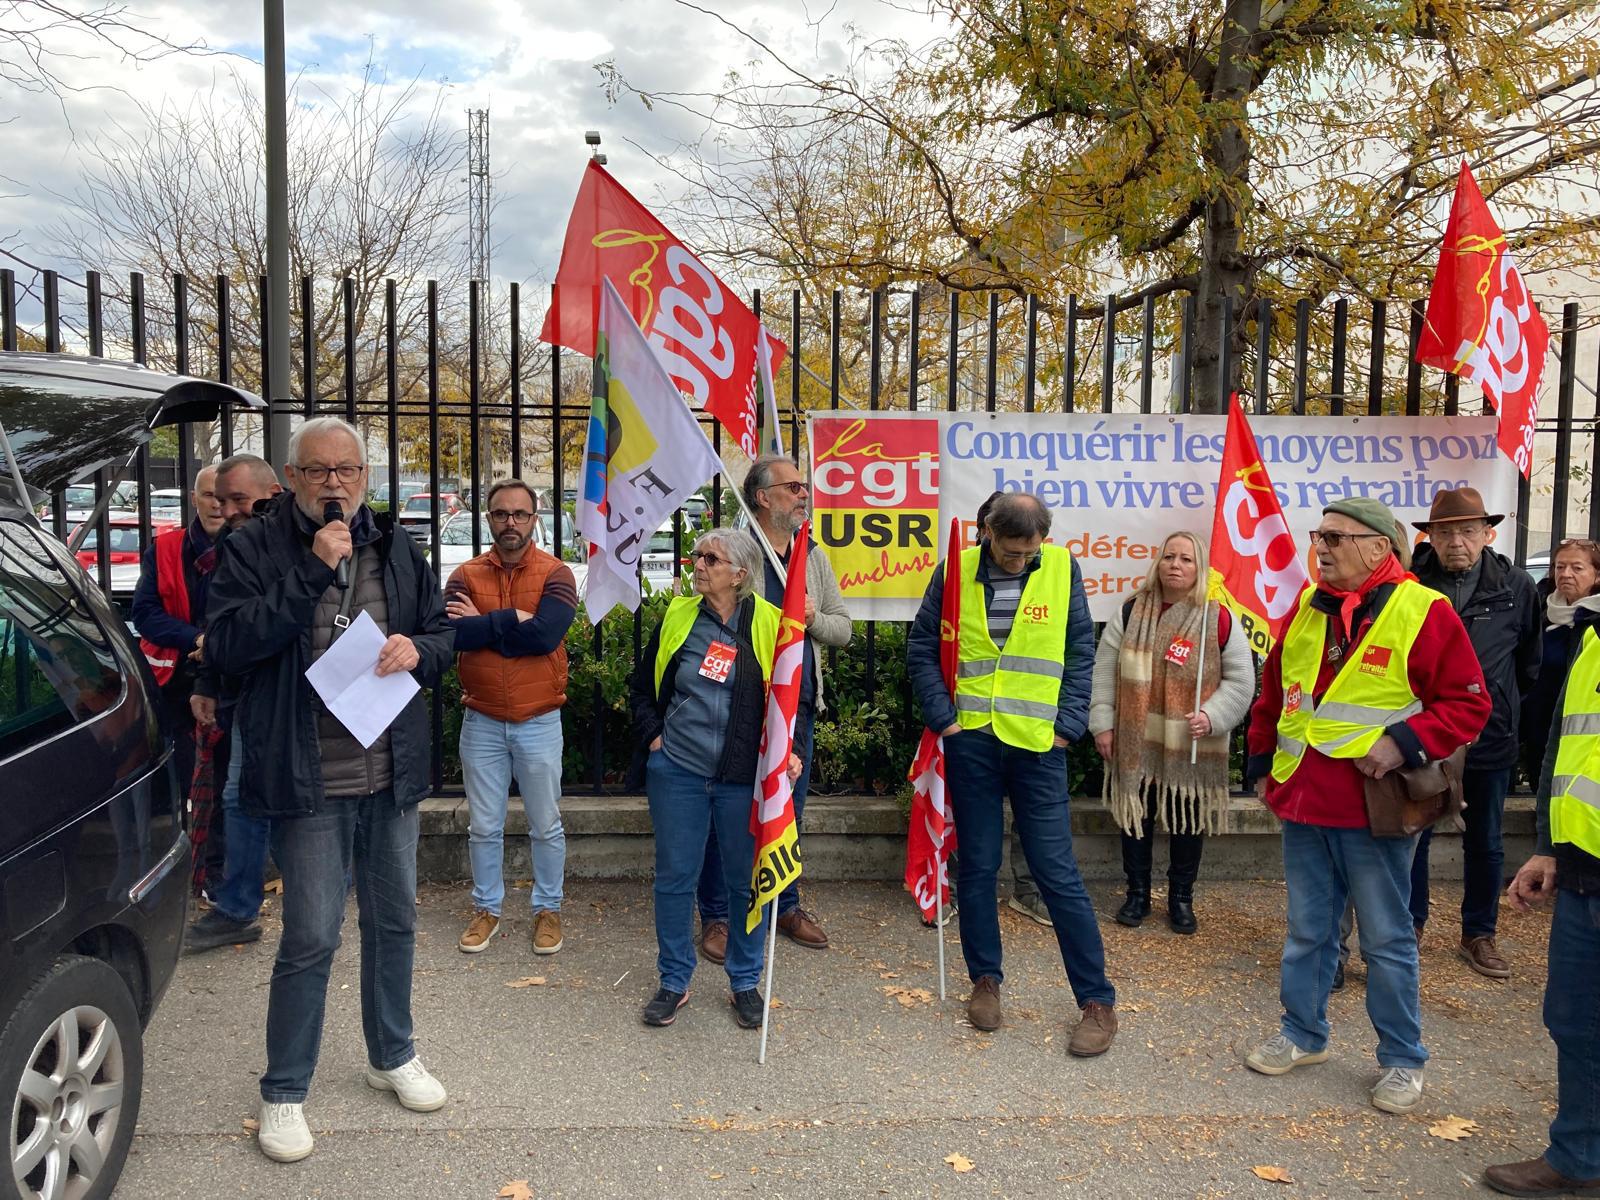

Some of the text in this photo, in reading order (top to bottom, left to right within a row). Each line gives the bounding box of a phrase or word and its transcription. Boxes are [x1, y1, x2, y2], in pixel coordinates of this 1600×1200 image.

[816, 418, 940, 462] la
[946, 420, 1167, 472] Conquérir
[1172, 422, 1226, 463] les
[1253, 434, 1404, 474] moyens
[814, 451, 940, 507] cgt
[993, 467, 1091, 508] bien
[1095, 470, 1205, 509] vivre
[820, 513, 934, 548] USR
[839, 550, 935, 591] aucluse
[1023, 604, 1048, 620] cgt
[703, 655, 732, 675] cgt
[1170, 643, 1191, 658] cgt
[704, 669, 722, 681] UFR
